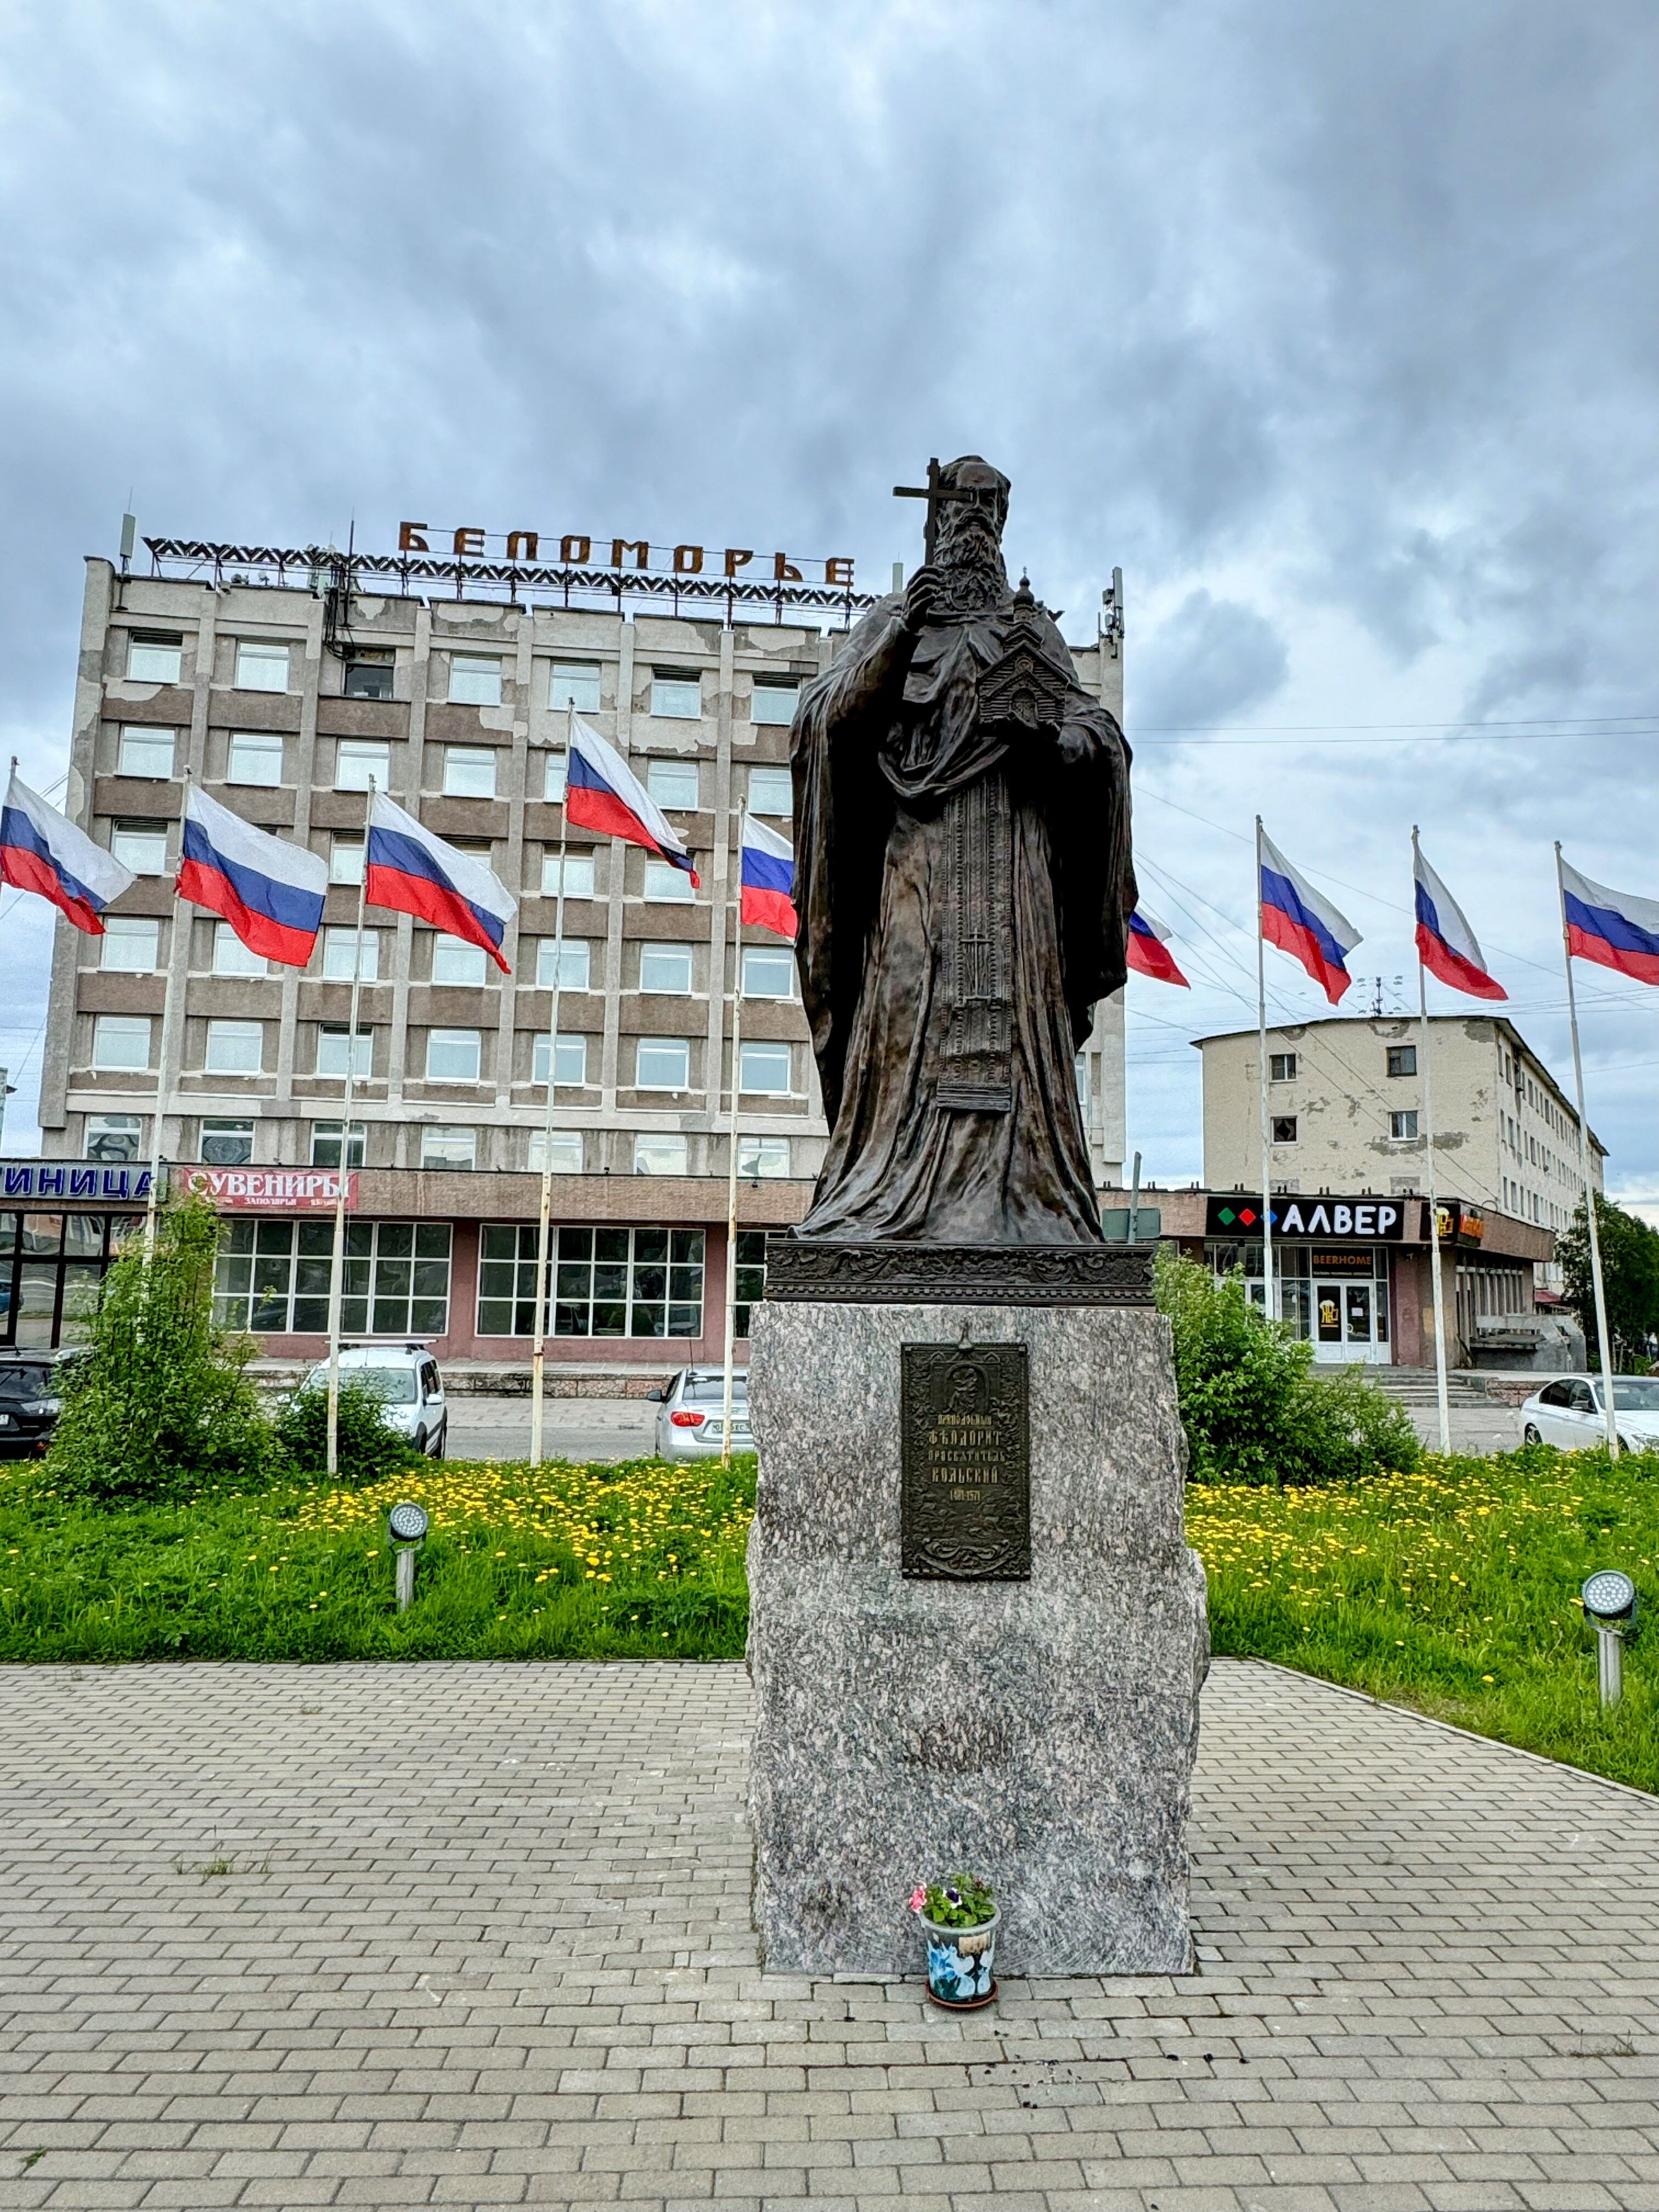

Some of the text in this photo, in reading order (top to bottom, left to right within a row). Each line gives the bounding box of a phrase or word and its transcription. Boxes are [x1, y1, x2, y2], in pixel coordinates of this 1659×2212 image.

[399, 522, 855, 586] БЕЛОМОРЬЕ
[0, 1167, 155, 1200] ИНИЦА
[188, 1172, 351, 1197] СУВЕНИРЫ
[1281, 1204, 1397, 1234] АЛВЕР
[1313, 1255, 1372, 1265] BEERHOME
[933, 1466, 997, 1483] КОЛЬСКИЙ
